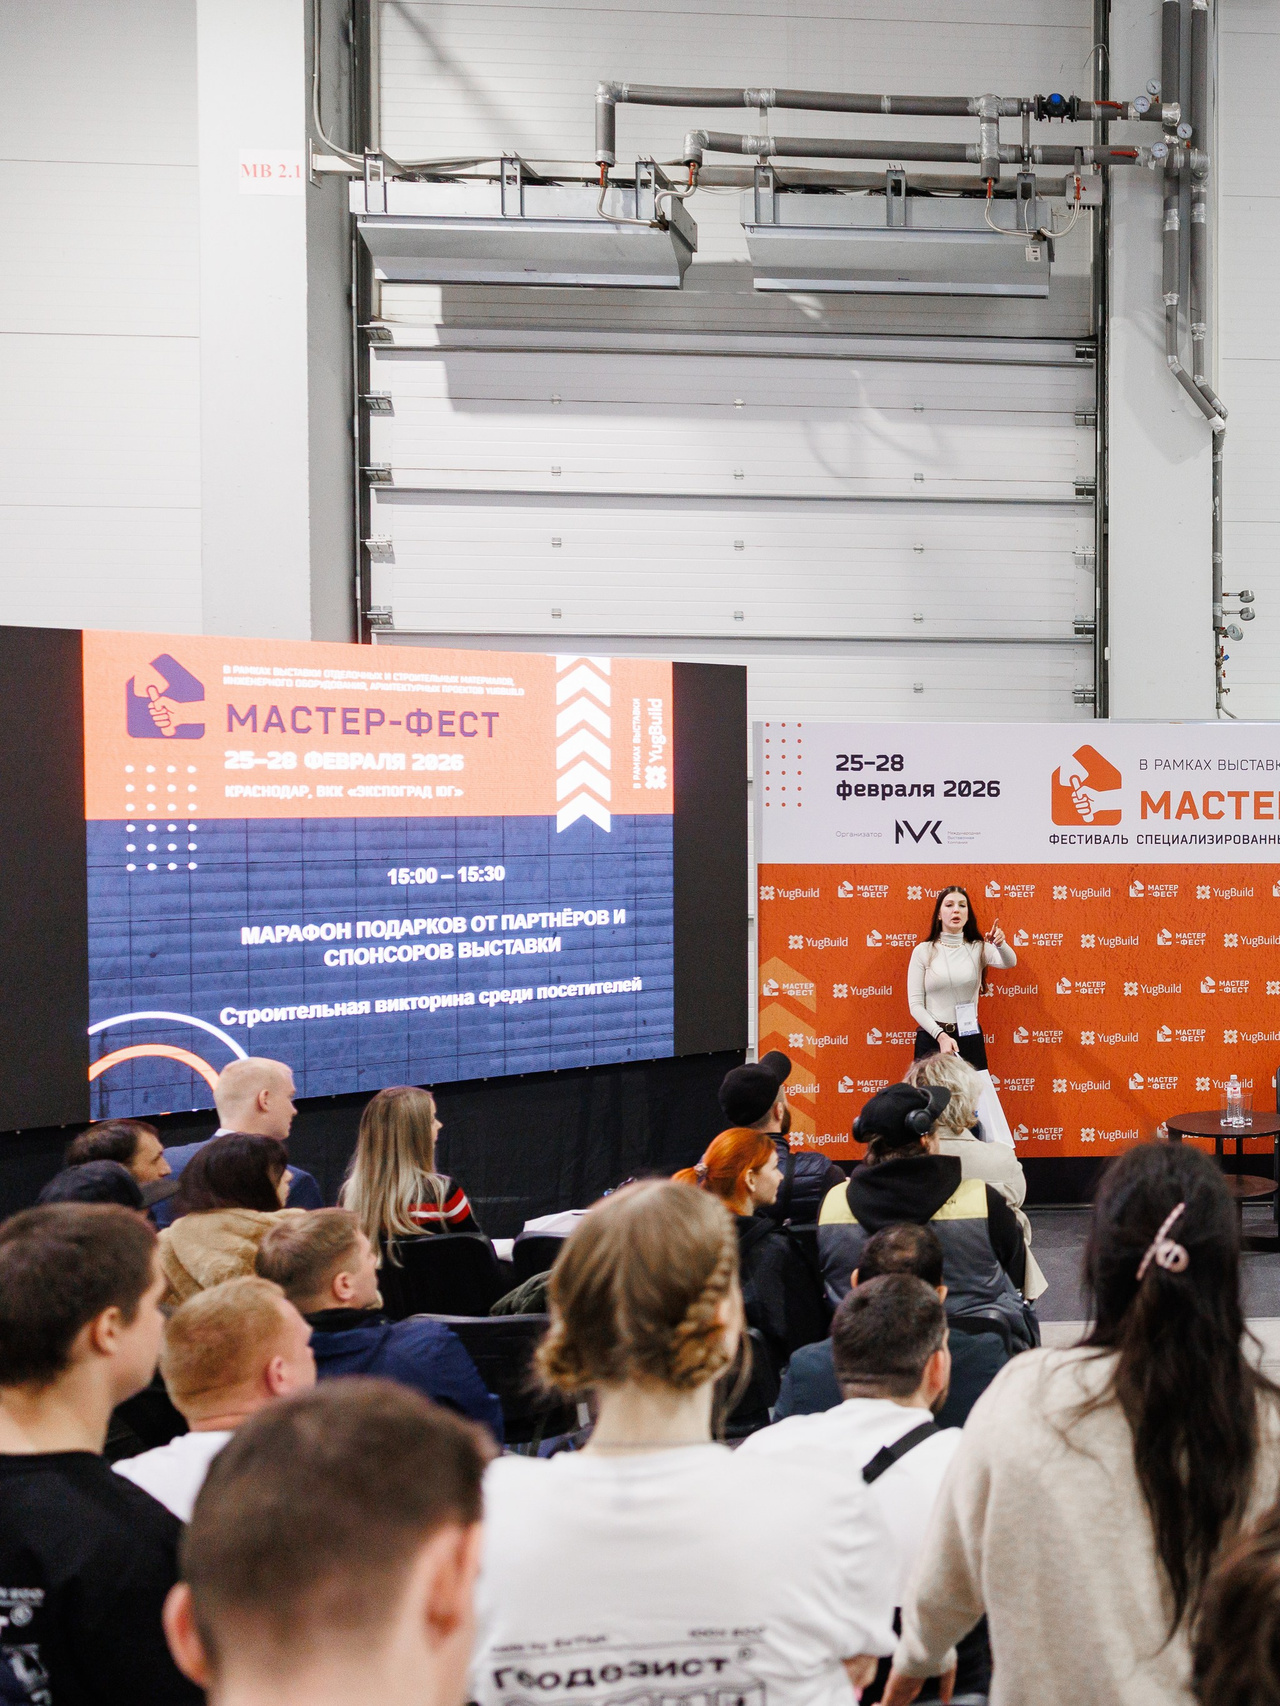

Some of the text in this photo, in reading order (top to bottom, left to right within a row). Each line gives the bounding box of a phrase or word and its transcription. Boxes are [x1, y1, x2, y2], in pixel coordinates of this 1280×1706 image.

[278, 164, 301, 178] 2.1
[226, 703, 500, 738] МАСТЕР-ФЕСТ
[647, 698, 667, 763] YugBuild
[303, 752, 406, 771] ФЕВРАЛЯ
[1139, 759, 1148, 771] В
[1154, 759, 1212, 771] РАМКАХ
[224, 784, 313, 800] КРАСНОДАР,
[316, 785, 343, 798] ВКК
[835, 780, 1001, 801] февраля 2026
[835, 831, 883, 839] Организатор
[1049, 833, 1129, 845] ФЕСТИВАЛЬ
[387, 868, 438, 885] 15:00
[457, 866, 506, 883] 15:30
[776, 887, 820, 900] YugBuild
[857, 891, 889, 899] -ФЕСТ
[1069, 887, 1111, 900] YugBuild
[1147, 890, 1178, 898] -ФЕСТ
[1212, 886, 1254, 899] YugBuild
[241, 908, 626, 945] МАРАФОН ПОДАРКОВ ОТ ПАРТНЁРОВ И
[805, 936, 849, 949] YugBuild
[1032, 932, 1064, 940] МАСТЕР
[1097, 935, 1139, 948] YugBuild
[1175, 938, 1206, 946] -ФЕСТ
[1239, 934, 1280, 947] YugBuild
[885, 940, 918, 948] -ФЕСТ
[1032, 939, 1063, 947] -ФЕСТ
[323, 937, 562, 966] СПОНСОРОВ ВЫСТАВКИ
[1074, 980, 1107, 988] МАСТЕР
[1140, 983, 1182, 996] YugBuild
[1218, 979, 1250, 987] МАСТЕР
[782, 989, 814, 997] -ФЕСТ
[849, 985, 893, 998] YugBuild
[995, 984, 1039, 997] YugBuild
[1075, 987, 1106, 995] -ФЕСТ
[1219, 986, 1249, 994] -ФЕСТ
[219, 976, 643, 1028] Строительная викторина среди посетителей
[1096, 1032, 1139, 1045] YugBuild
[1175, 1028, 1206, 1036] МАСТЕР
[1239, 1030, 1280, 1043] YugBuild
[804, 1034, 849, 1047] YugBuild
[1032, 1036, 1063, 1044] -ФЕСТ
[1175, 1035, 1206, 1043] -ФЕСТ
[1003, 1077, 1036, 1085] МАСТЕР
[1069, 1079, 1111, 1092] YugBuild
[1147, 1082, 1178, 1090] -ФЕСТ
[784, 1083, 820, 1097] ugBuild
[857, 1086, 888, 1094] -ФЕС
[1004, 1084, 1035, 1092] -ФЕСТ
[805, 1132, 849, 1146] YugBuild
[1032, 1133, 1063, 1141] -ФЕСТ
[1096, 1128, 1139, 1142] YugBuild
